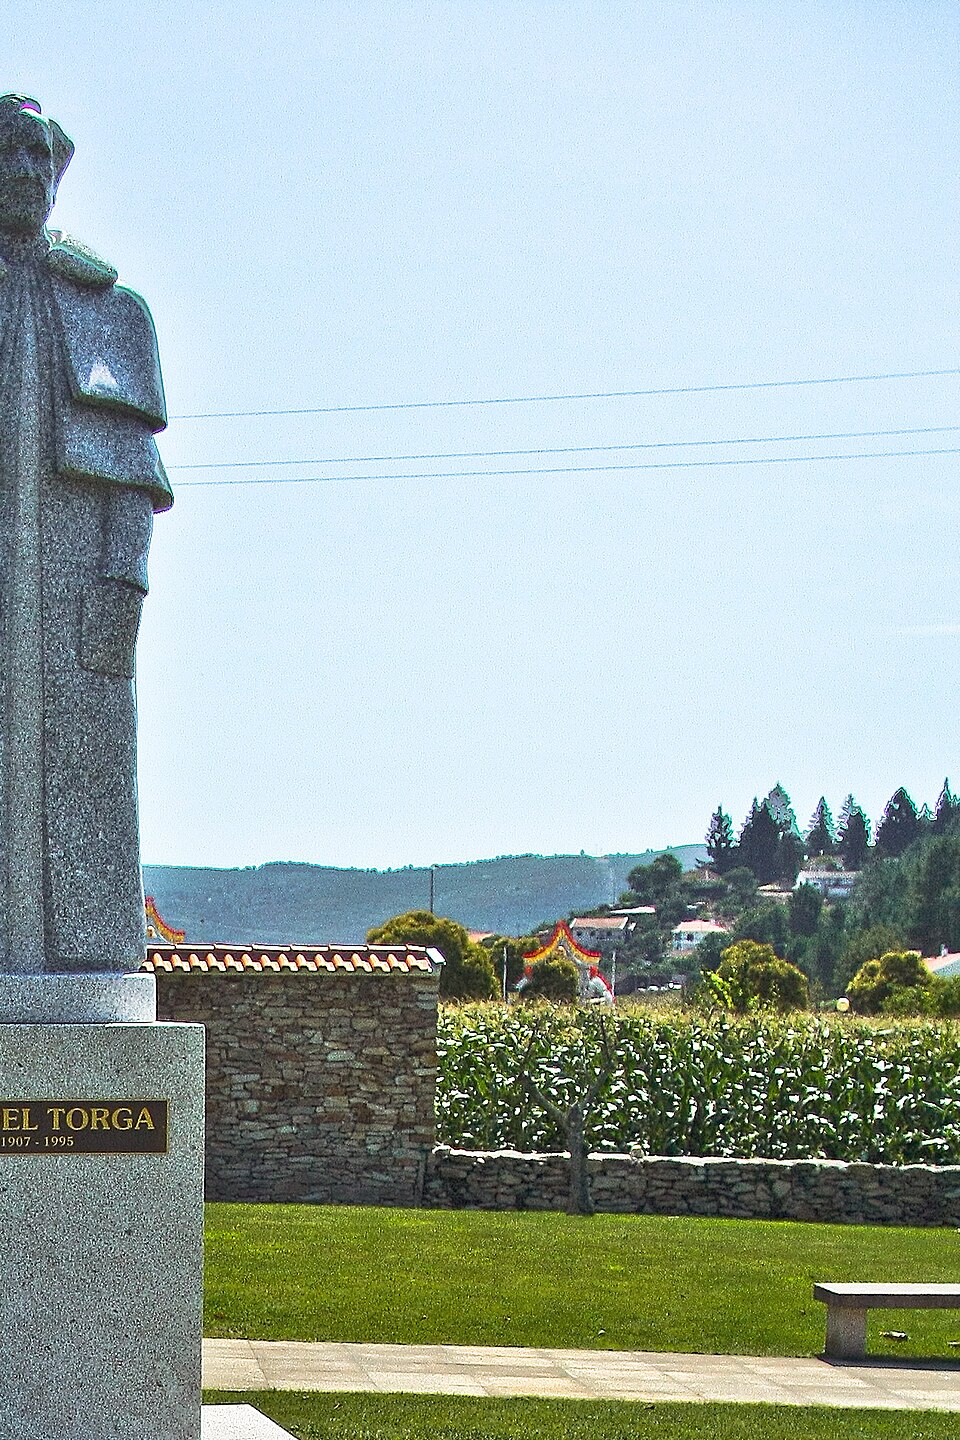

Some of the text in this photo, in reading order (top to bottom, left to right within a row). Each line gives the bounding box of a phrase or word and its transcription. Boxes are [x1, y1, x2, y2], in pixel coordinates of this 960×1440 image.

[47, 1107, 155, 1131] TORGA
[1, 1136, 31, 1147] 1907
[44, 1136, 74, 1147] 1995
